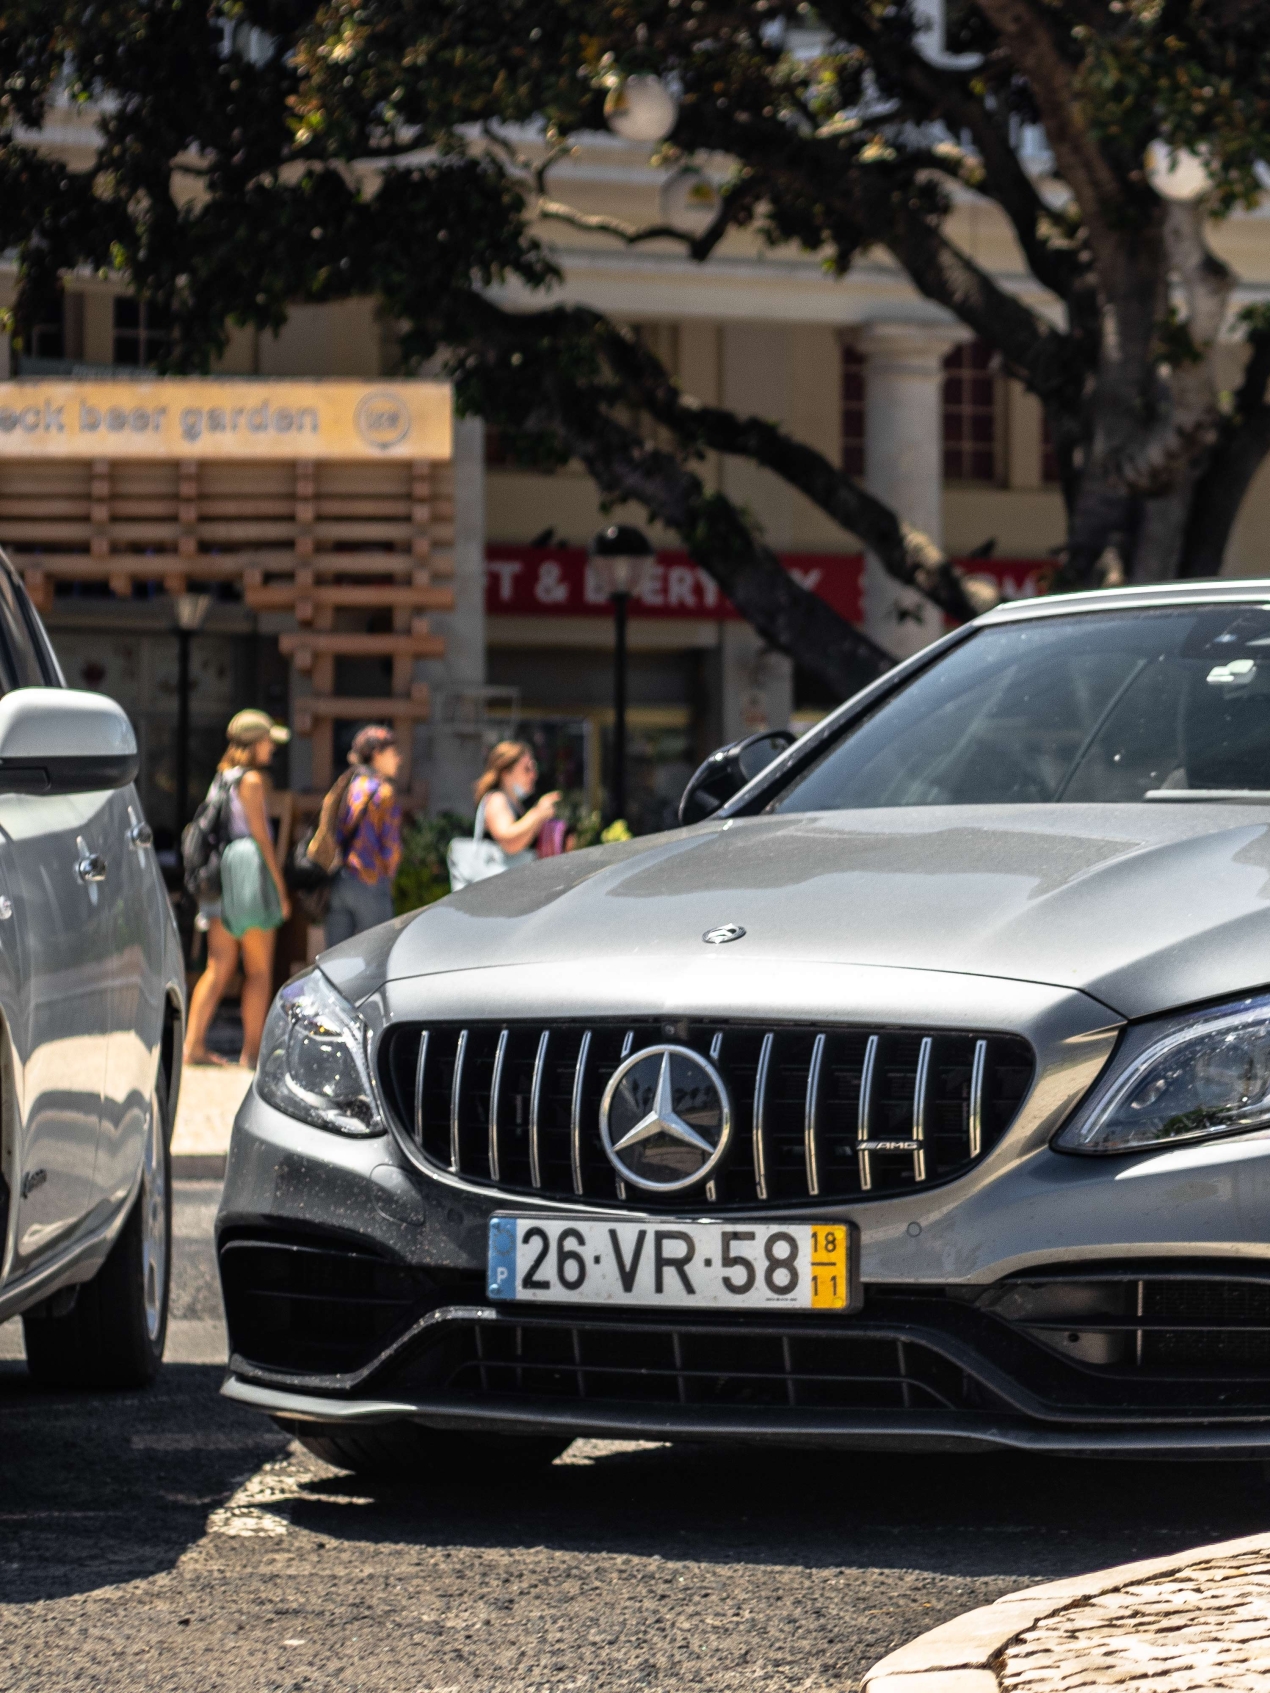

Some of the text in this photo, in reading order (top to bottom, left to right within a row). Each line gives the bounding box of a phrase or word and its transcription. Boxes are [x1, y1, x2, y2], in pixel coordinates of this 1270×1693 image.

[79, 399, 167, 432] beer
[181, 400, 320, 443] garden
[534, 561, 570, 602] &
[811, 1231, 837, 1253] 18
[496, 1268, 508, 1284] P
[811, 1275, 838, 1296] 11
